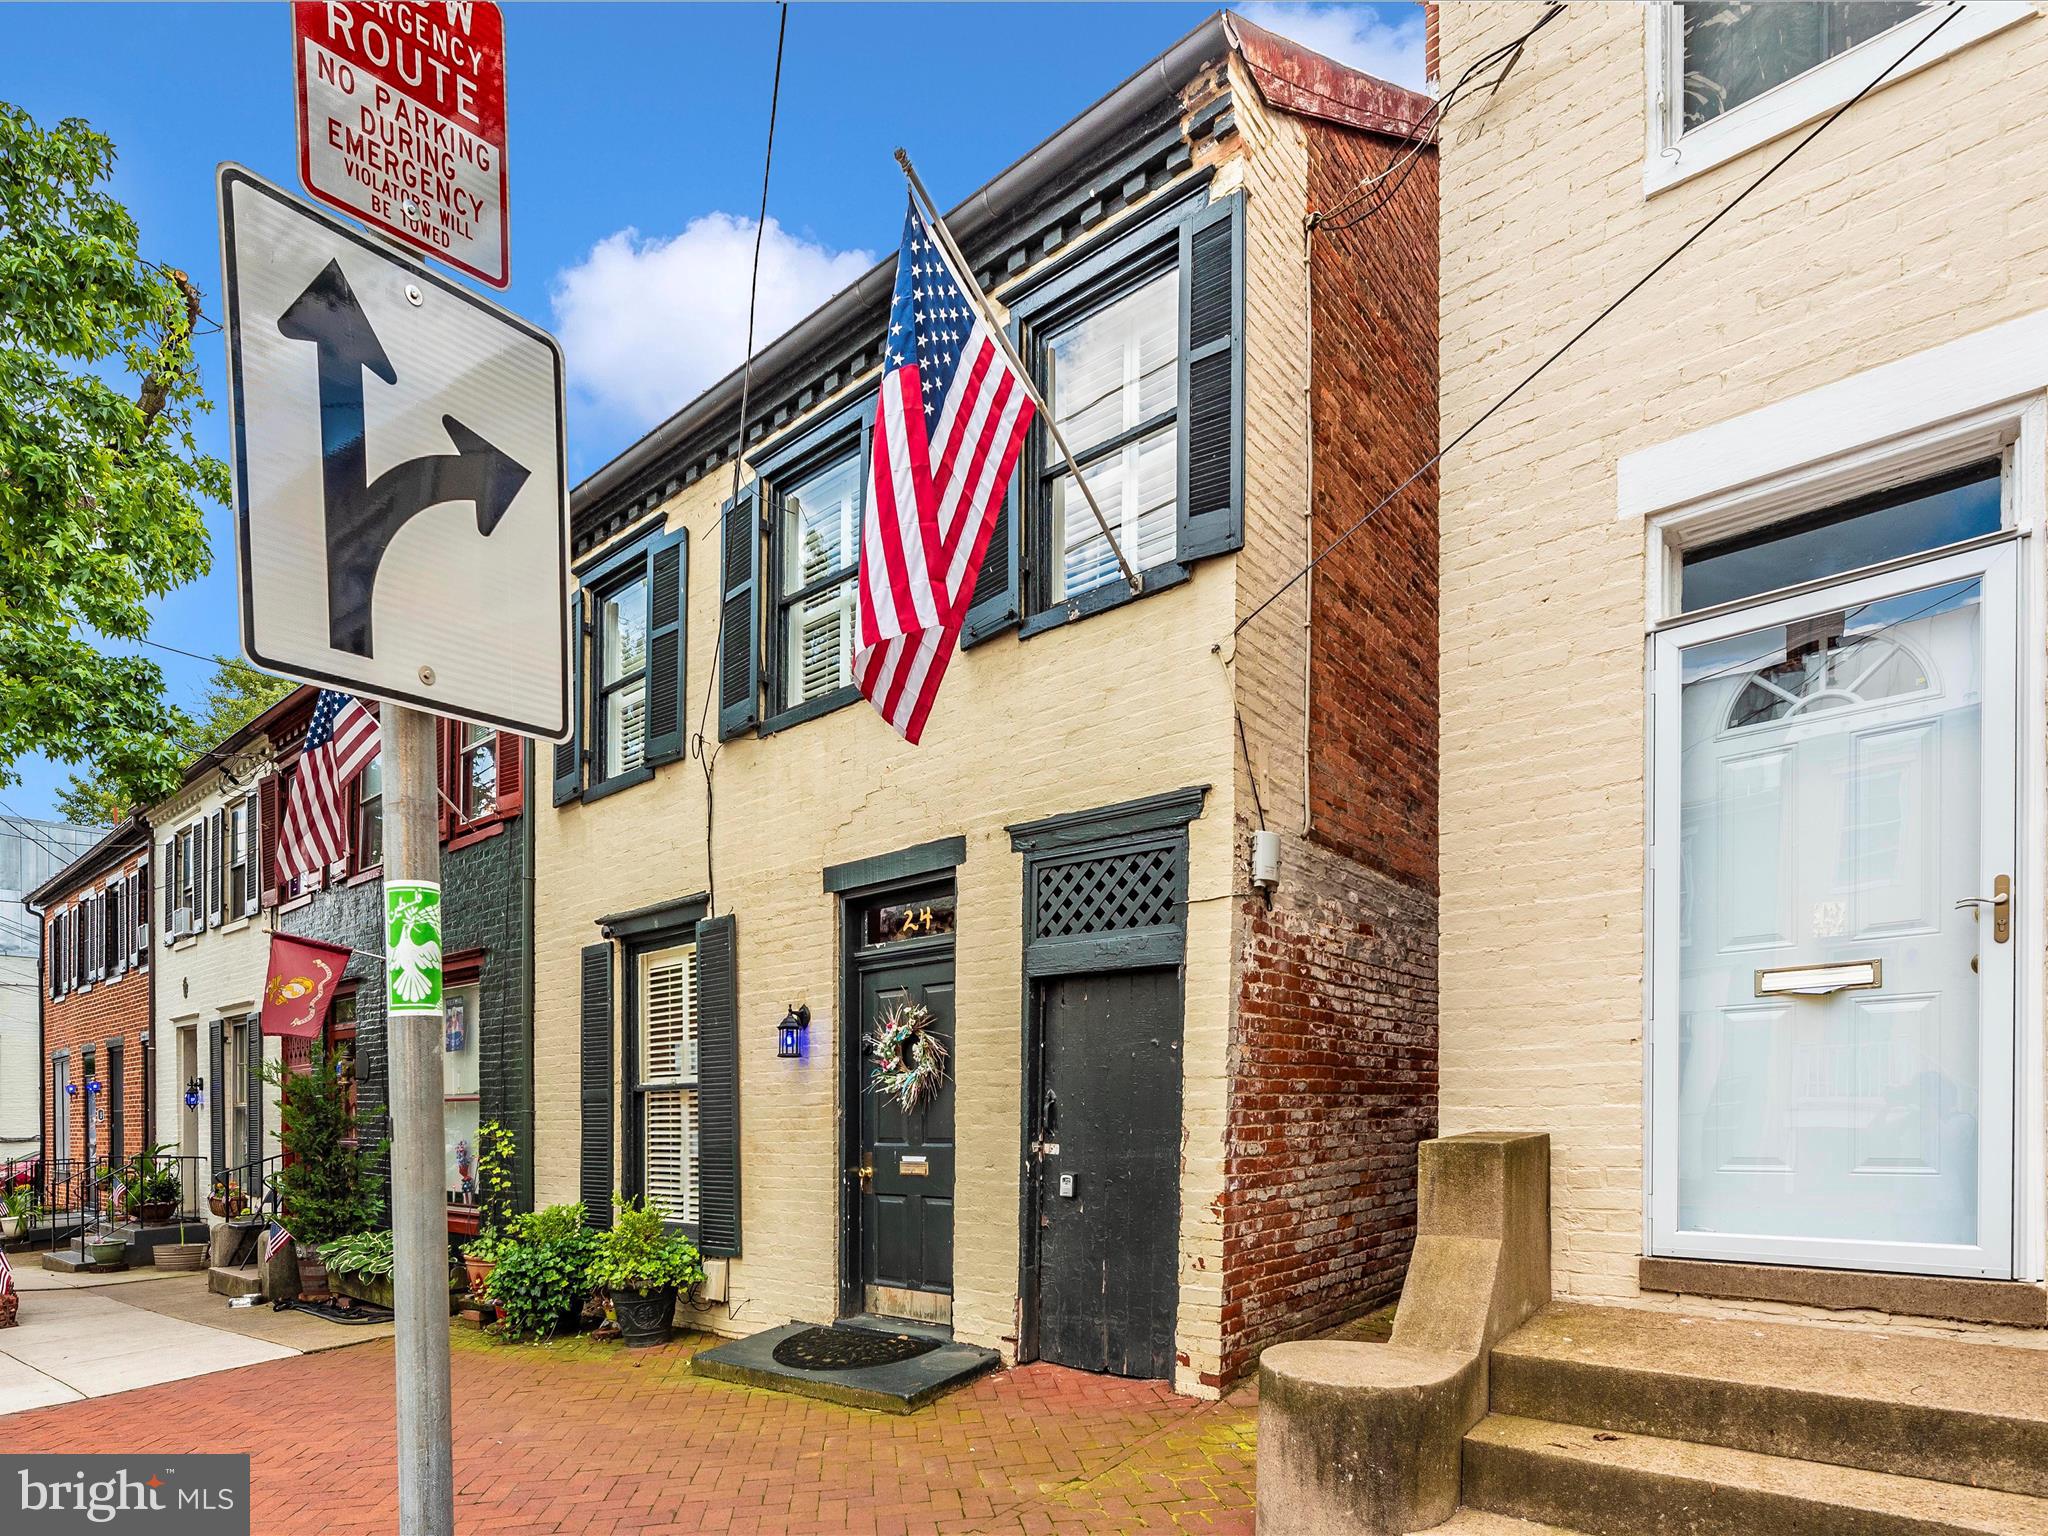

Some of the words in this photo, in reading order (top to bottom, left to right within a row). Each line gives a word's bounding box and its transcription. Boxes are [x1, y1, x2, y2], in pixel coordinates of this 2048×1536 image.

[327, 1, 480, 124] ROUTE
[318, 51, 355, 94] NO
[375, 84, 490, 172] PARKING
[360, 105, 455, 180] DURING
[328, 117, 484, 223] EMERGENCY
[371, 194, 391, 220] BE
[400, 208, 450, 248] TOWED
[439, 208, 473, 241] WILL
[903, 906, 933, 932] 24
